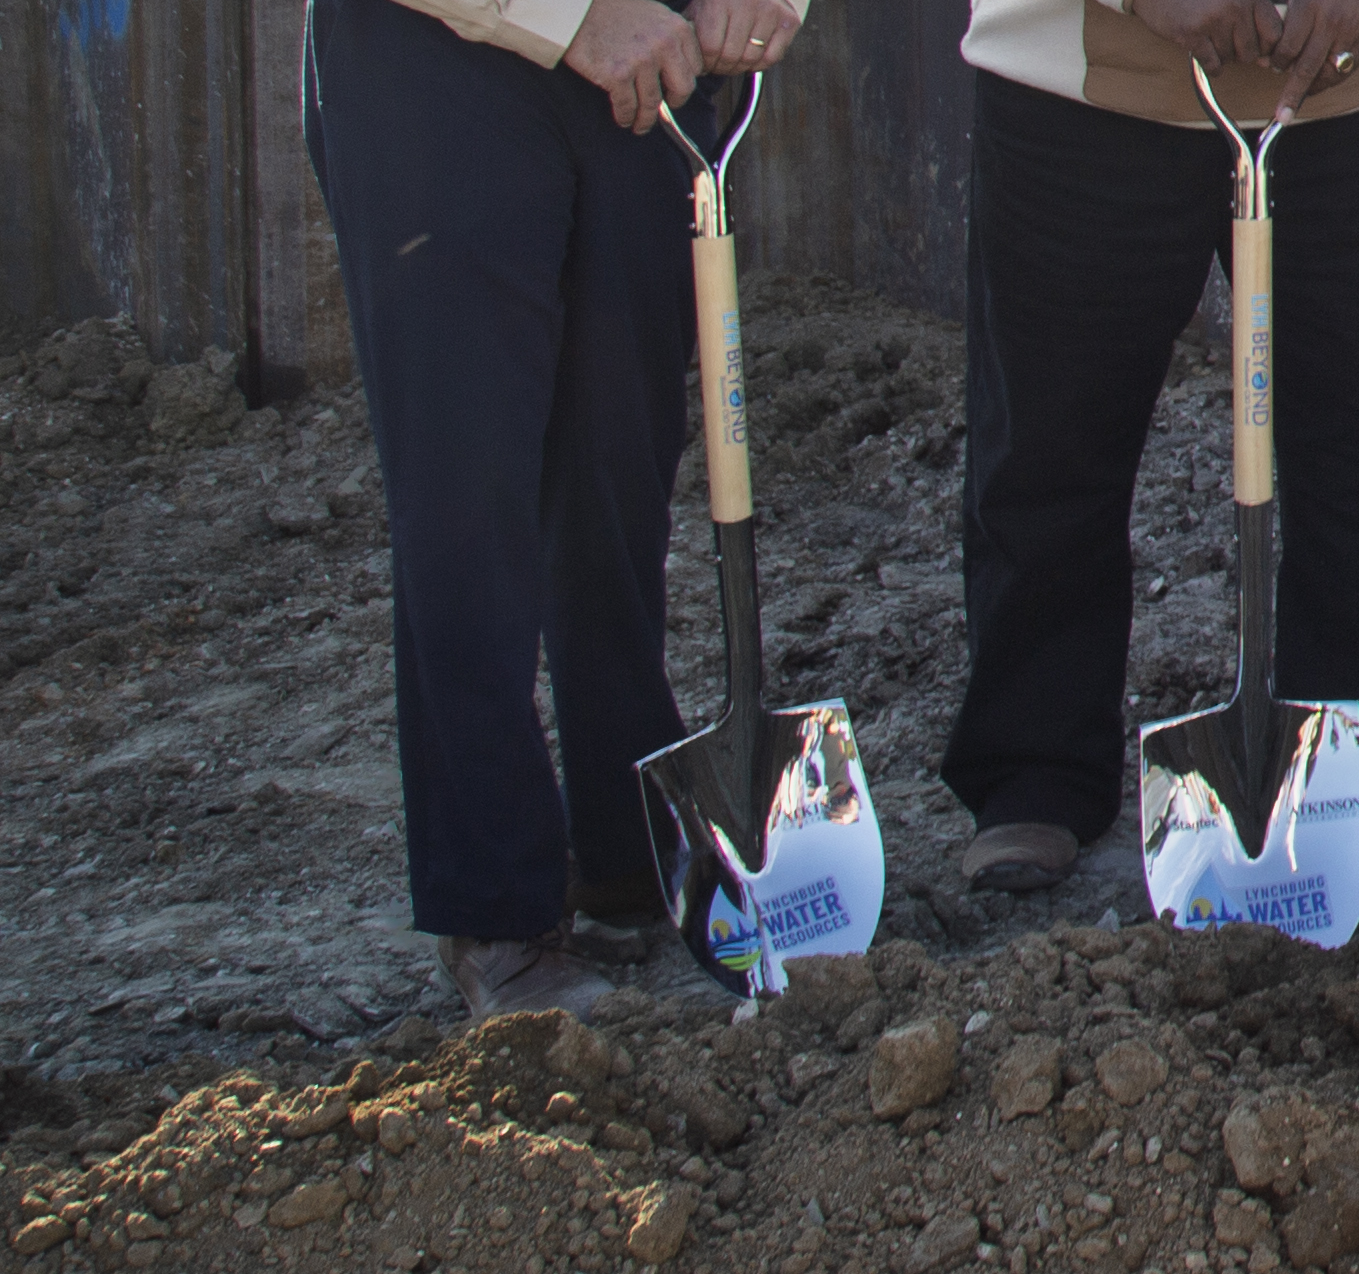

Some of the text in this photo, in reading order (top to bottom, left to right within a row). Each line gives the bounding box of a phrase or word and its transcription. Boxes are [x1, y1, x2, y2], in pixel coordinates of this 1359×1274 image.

[726, 348, 747, 444] BEYOND
[1251, 331, 1269, 426] BEYOND
[1245, 875, 1326, 902] LYNCHBURG
[1248, 890, 1328, 924] WATER
[762, 892, 843, 936] WATER
[772, 912, 851, 952] RESOURCES
